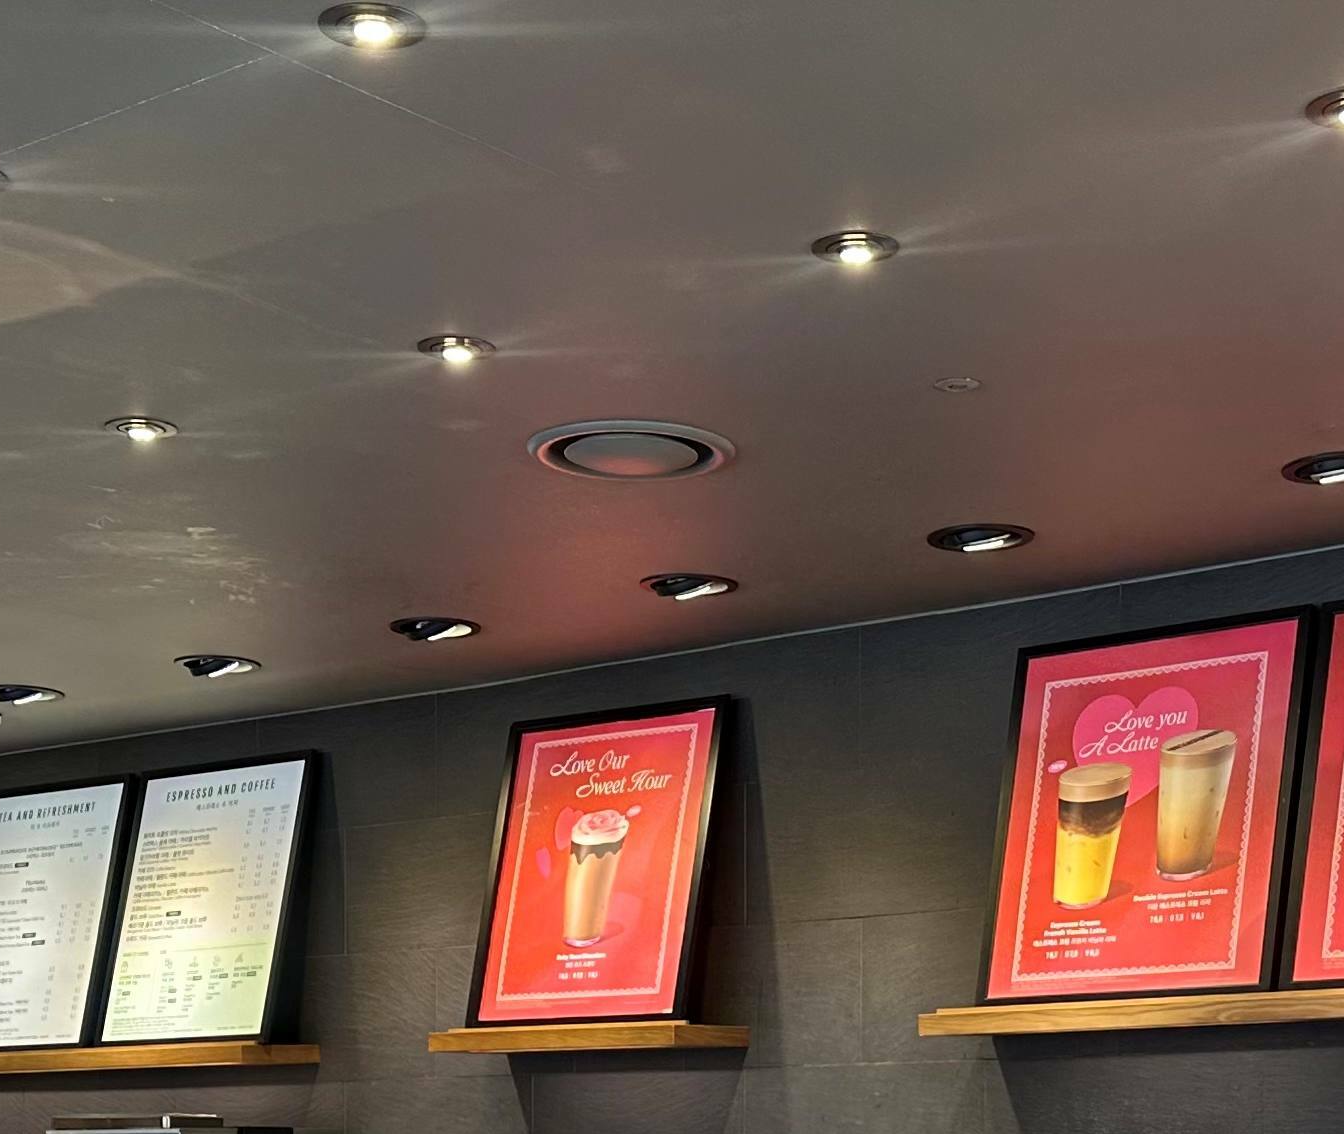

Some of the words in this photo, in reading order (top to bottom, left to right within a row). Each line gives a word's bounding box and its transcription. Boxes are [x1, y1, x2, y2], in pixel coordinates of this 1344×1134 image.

[1104, 710, 1155, 733] Love
[1158, 710, 1188, 730] you
[1078, 736, 1107, 758] A
[1107, 731, 1159, 755] Latte
[549, 750, 594, 777] Love
[600, 749, 631, 773] Our
[166, 785, 214, 803] ESPRESSO
[217, 782, 238, 797] AND
[240, 777, 276, 794] COFFEE
[575, 773, 626, 798] Sweet
[627, 769, 672, 792] Hour
[16, 808, 34, 821] AND
[36, 801, 96, 819] REFRESHMENT
